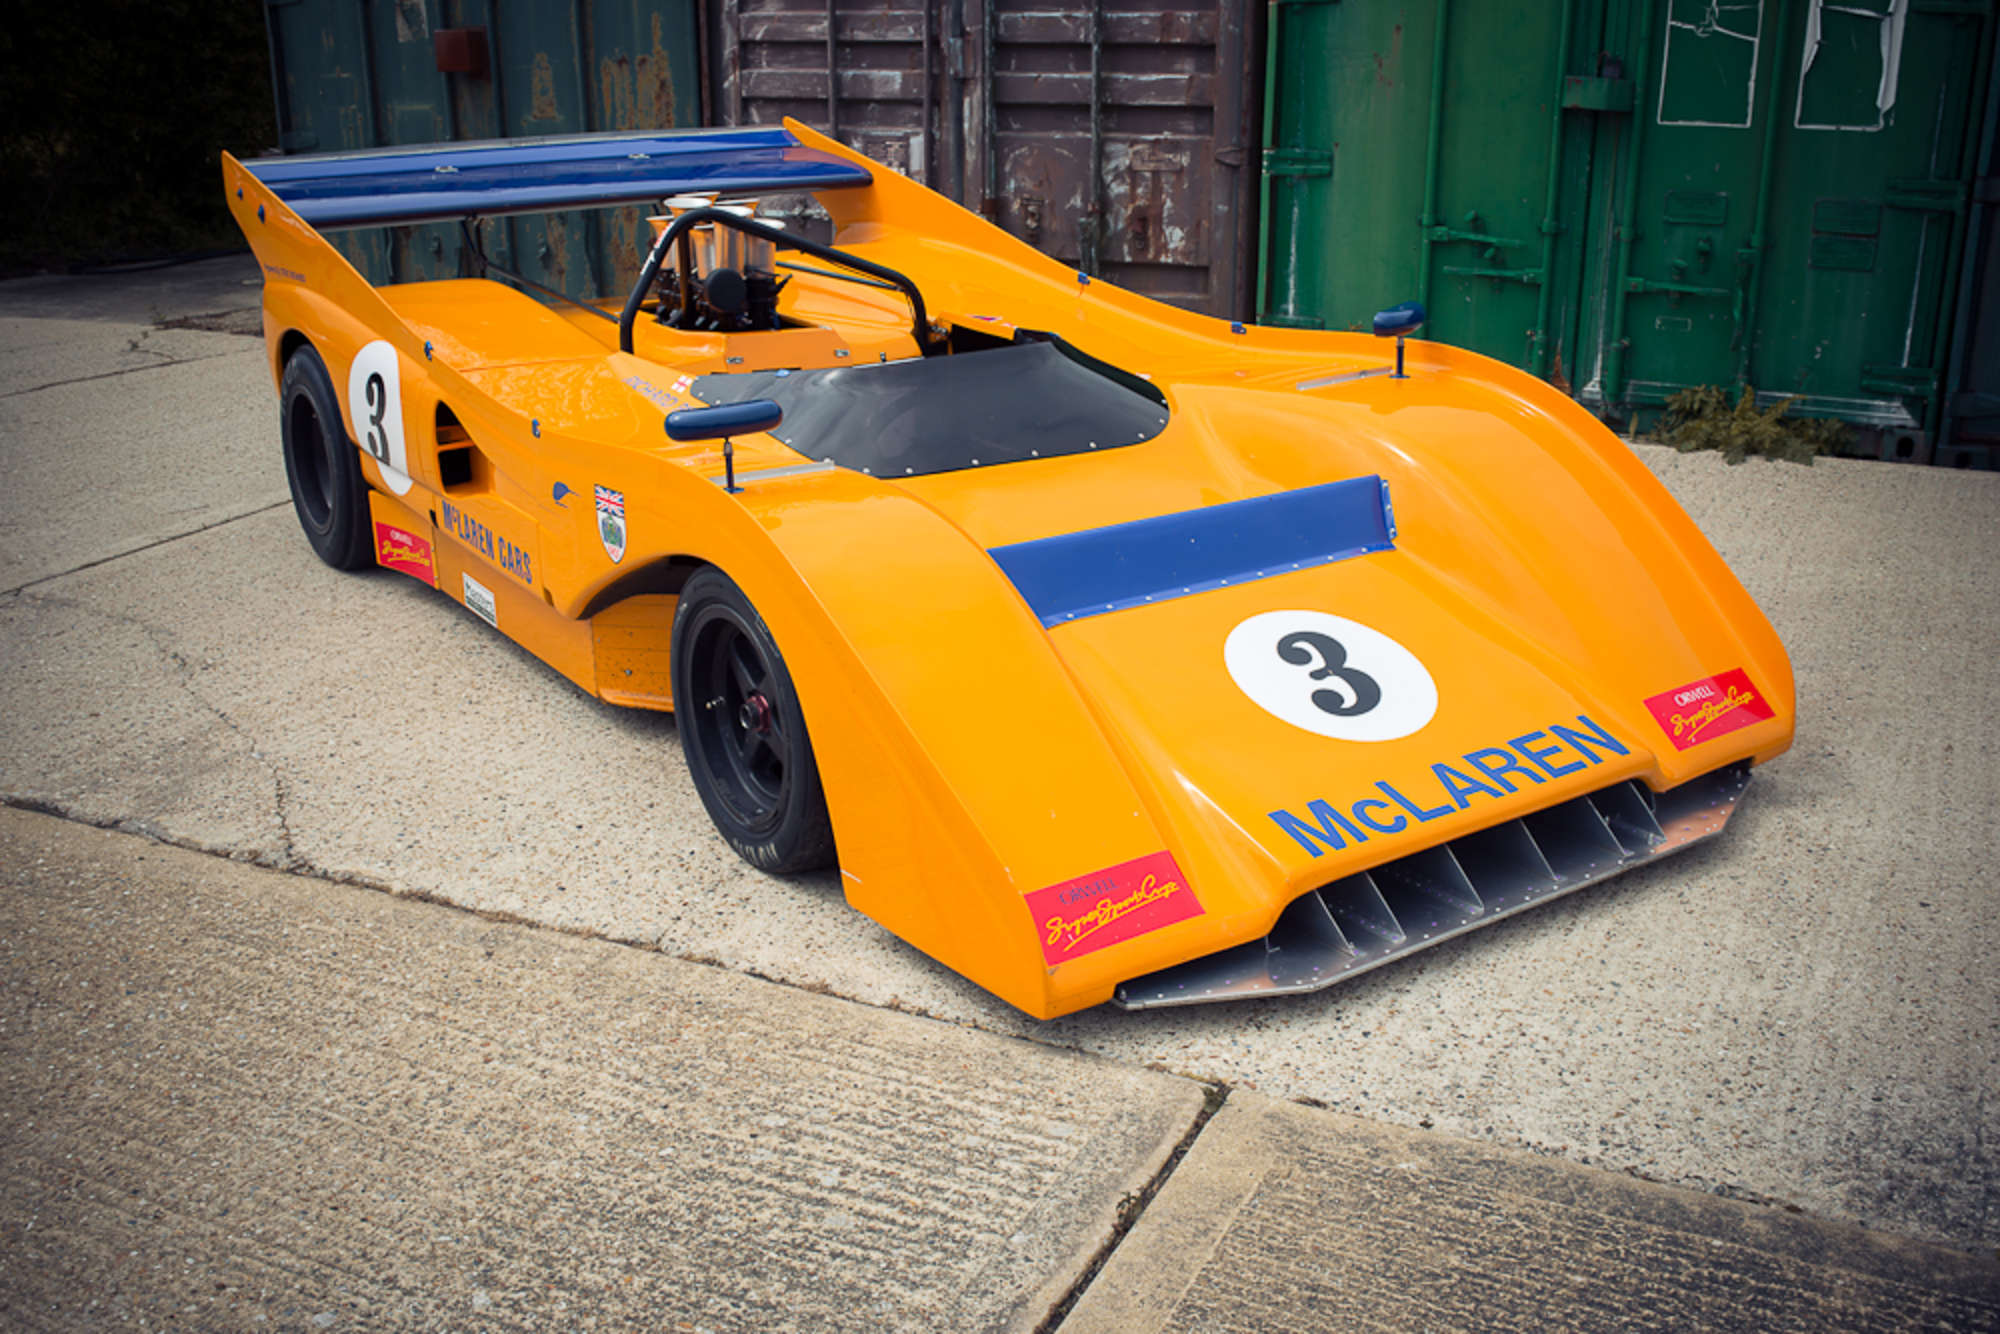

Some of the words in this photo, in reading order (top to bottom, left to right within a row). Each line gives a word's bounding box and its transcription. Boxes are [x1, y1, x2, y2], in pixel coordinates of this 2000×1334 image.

[366, 371, 391, 467] 3
[498, 535, 533, 585] CARS
[1276, 631, 1381, 717] 3
[1674, 685, 1715, 706] ORWELL
[1267, 714, 1631, 858] McLAREN
[1058, 877, 1119, 905] ORWELL
